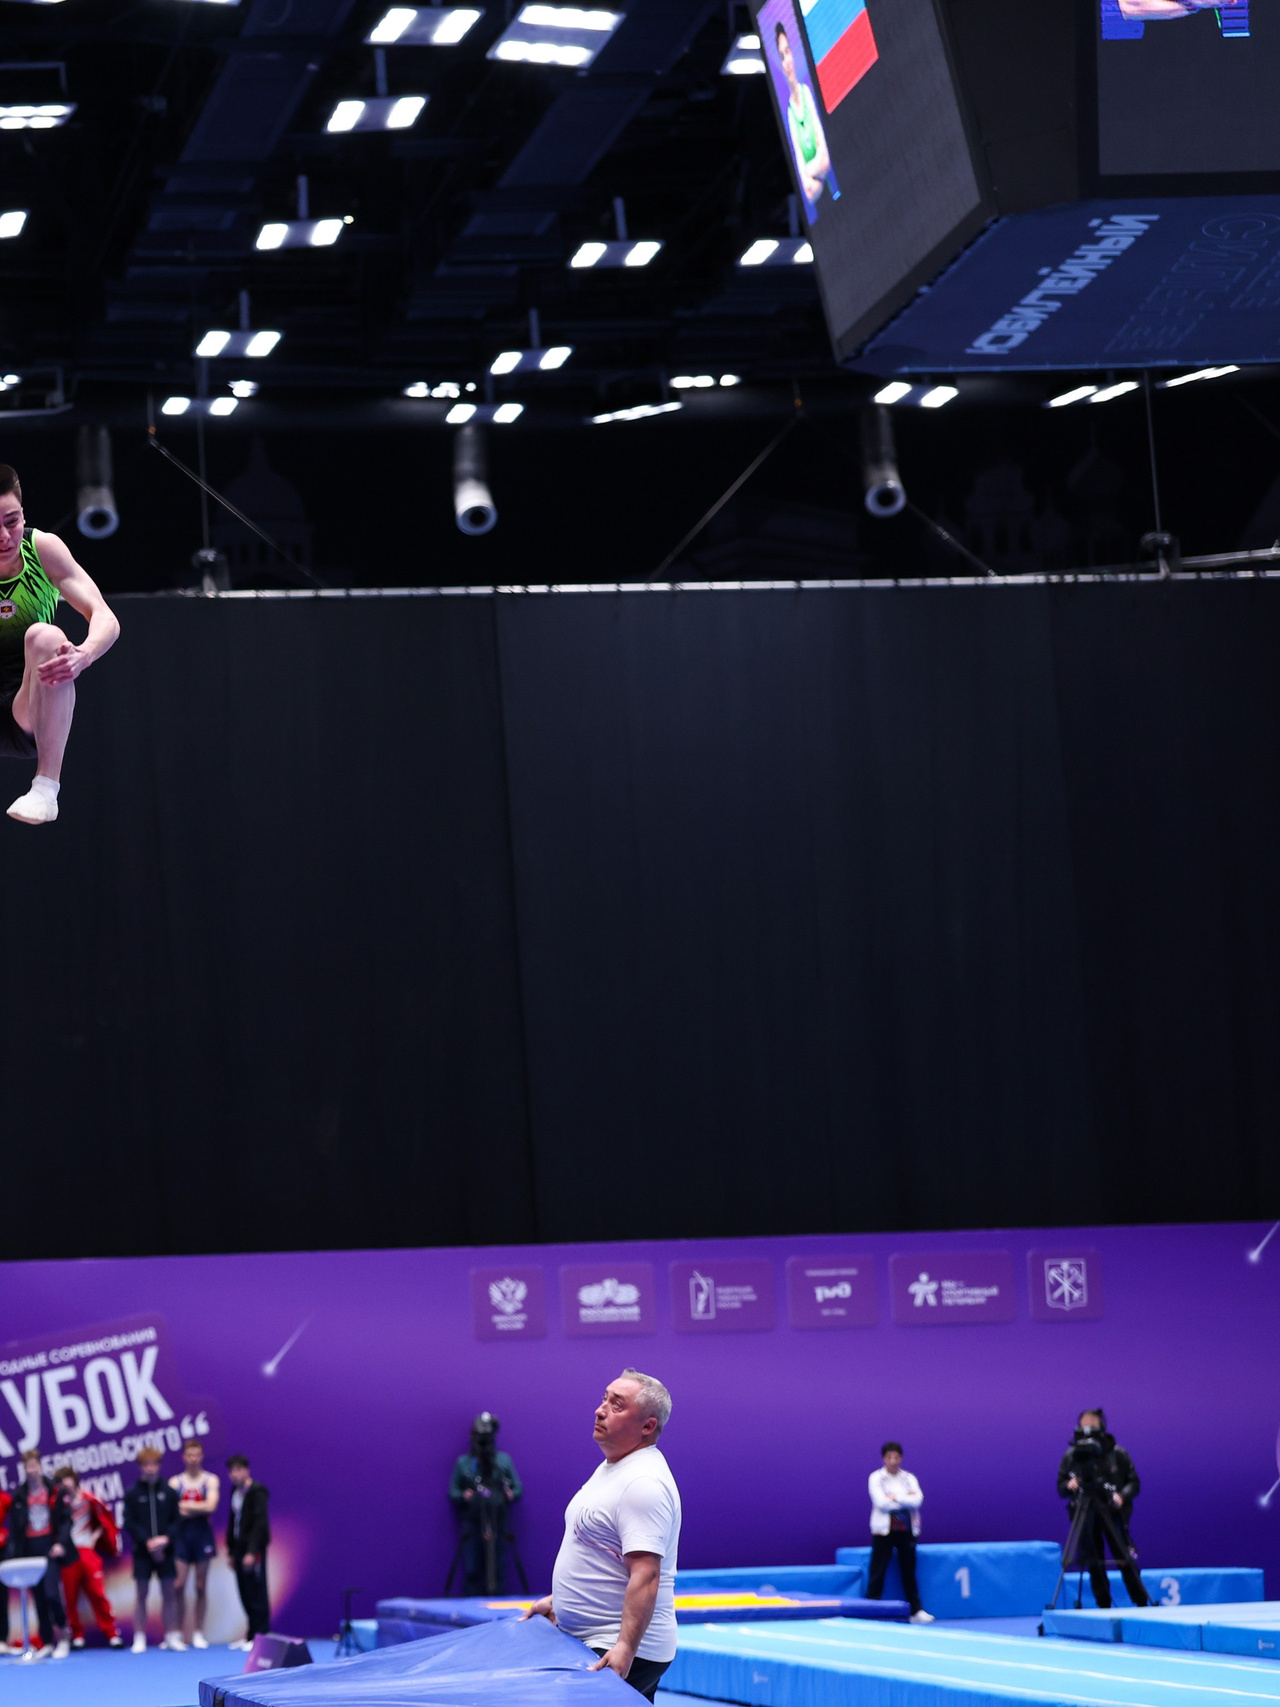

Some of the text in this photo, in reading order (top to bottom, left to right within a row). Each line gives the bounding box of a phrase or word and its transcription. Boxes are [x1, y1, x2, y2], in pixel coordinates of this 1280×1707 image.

[965, 213, 1160, 354] ЮБИЛЕЙНЫЙ
[48, 1326, 158, 1365] СОРЕВНОВАНИЯ
[954, 1566, 970, 1599] 1
[1160, 1577, 1181, 1607] 3
